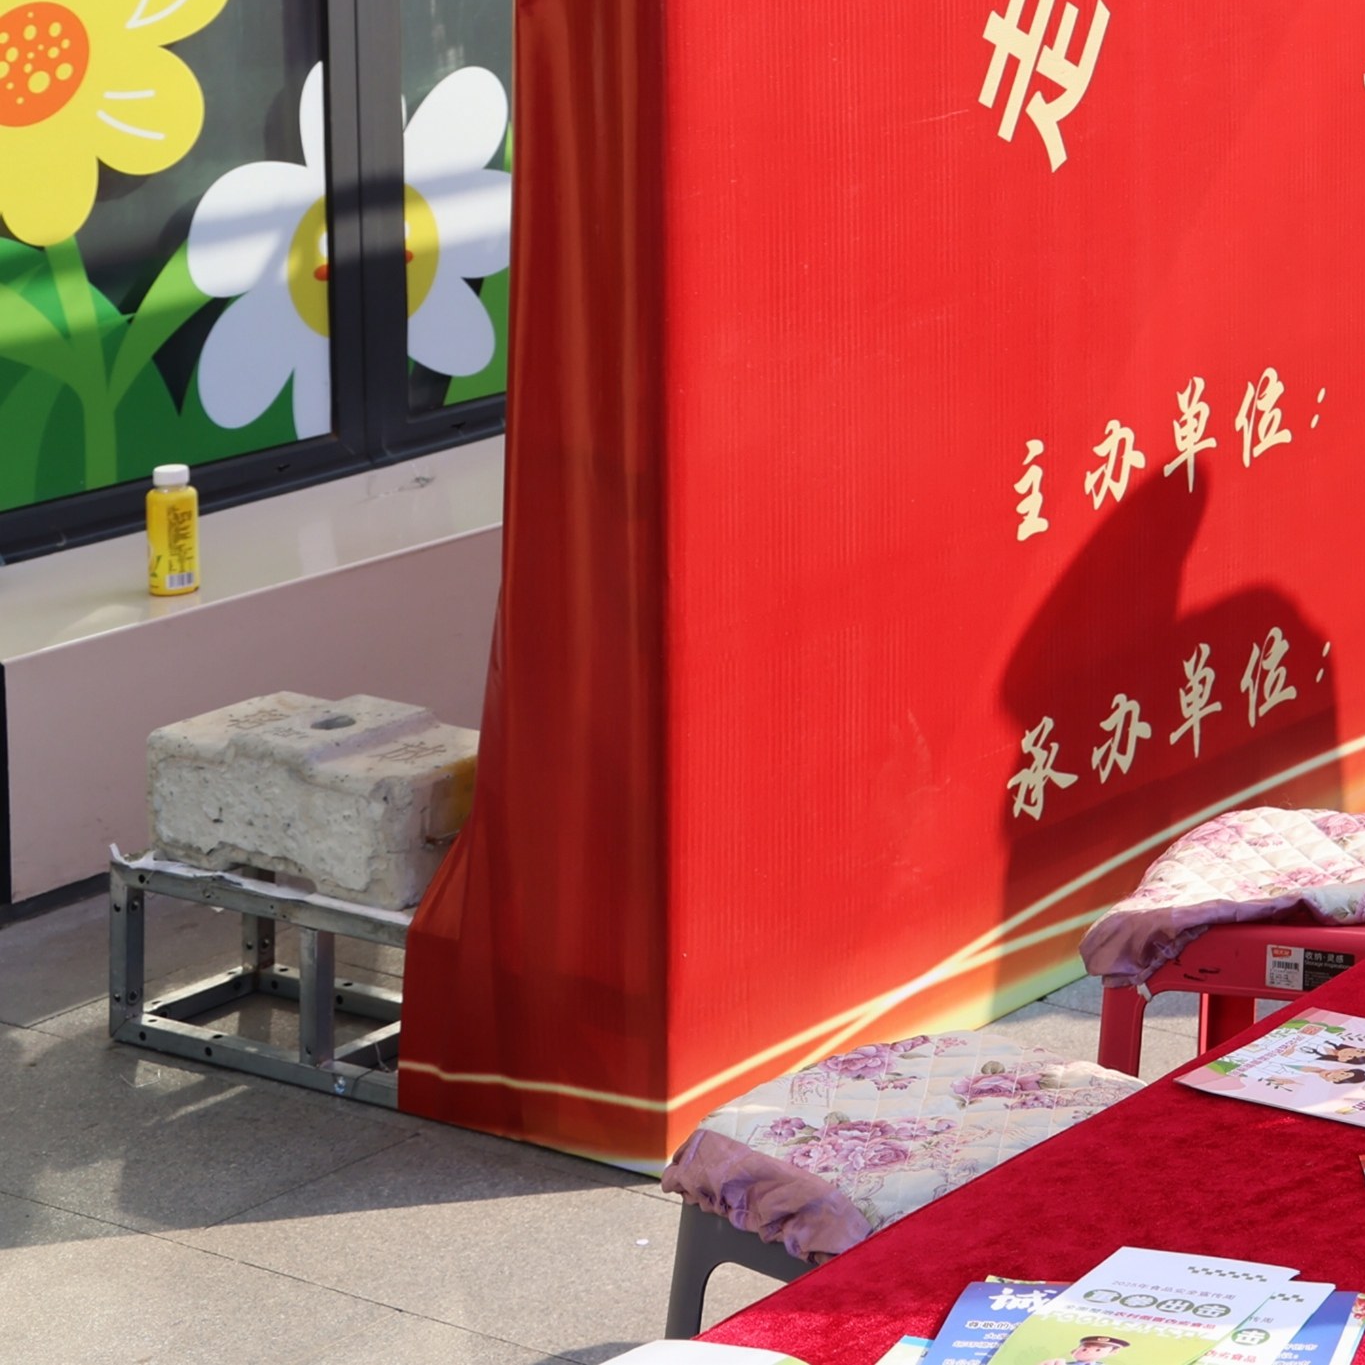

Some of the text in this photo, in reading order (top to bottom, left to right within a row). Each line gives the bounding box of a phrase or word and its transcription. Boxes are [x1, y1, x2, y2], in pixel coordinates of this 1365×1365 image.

[1012, 366, 1327, 542] 主办单位：
[1006, 626, 1332, 821] 承办单位：
